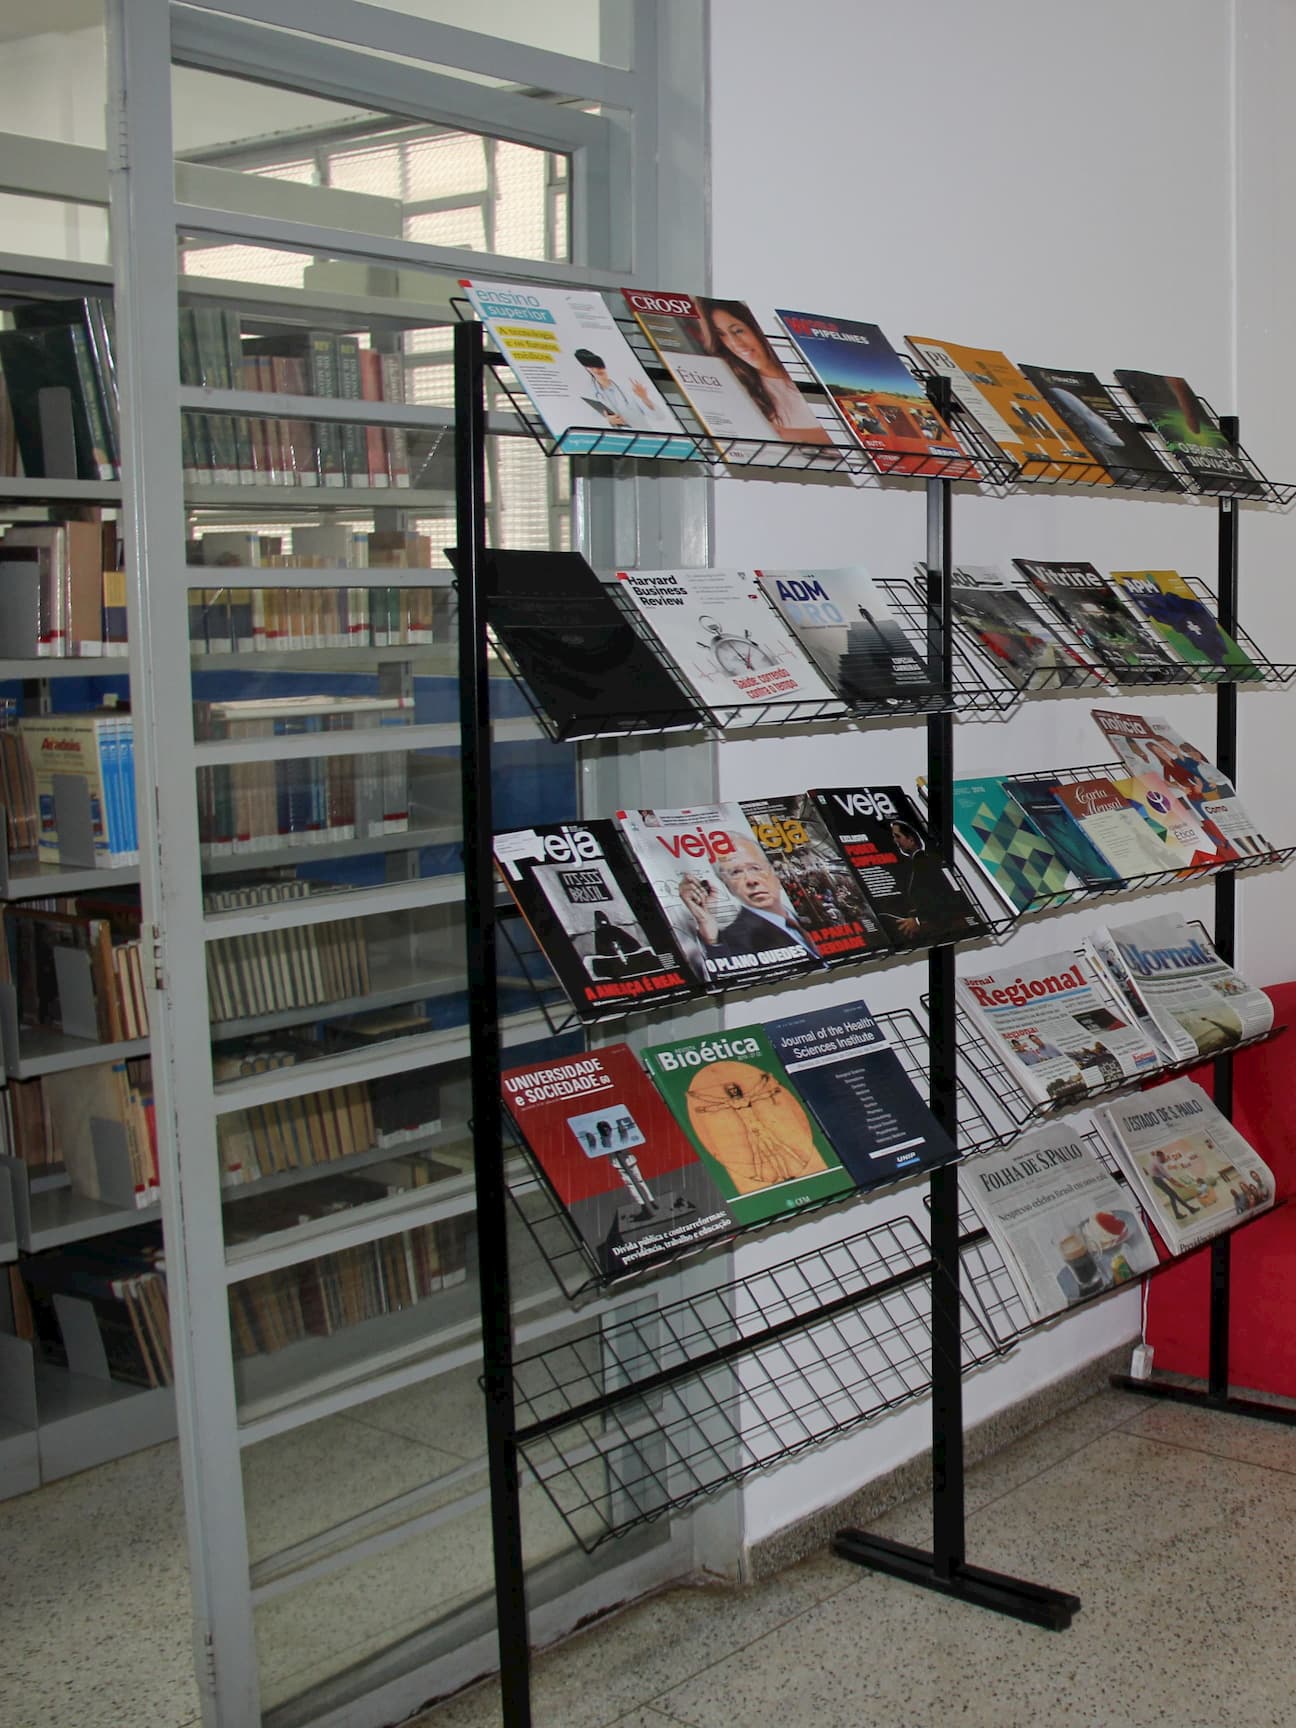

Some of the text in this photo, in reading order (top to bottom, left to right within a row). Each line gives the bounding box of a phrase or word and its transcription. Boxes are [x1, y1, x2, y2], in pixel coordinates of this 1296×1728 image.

[476, 288, 540, 307] ensino
[631, 296, 692, 315] CROSP
[488, 304, 547, 321] superior
[811, 328, 869, 345] PIPELINES
[924, 350, 956, 368] PB
[677, 366, 722, 387] Ética
[628, 575, 677, 587] Harvard
[1024, 564, 1104, 587] Vitrine
[1122, 577, 1161, 594] APM
[633, 586, 688, 597] Business
[640, 597, 685, 607] Review
[775, 580, 830, 602] ADM
[784, 602, 843, 624] PRO
[832, 788, 899, 822] veja
[1075, 785, 1108, 804] Carta
[1082, 798, 1124, 818] Mensal
[656, 826, 737, 865] veja
[705, 944, 808, 973] O PLANO GUEDES
[964, 975, 996, 987] Jornal
[968, 965, 1088, 1007] Regional
[780, 1016, 876, 1048] Journal of the Health
[657, 1037, 761, 1071] Bioética
[793, 1031, 876, 1058] Sciences Institute
[504, 1057, 605, 1092] UNIVERSIDADE
[514, 1095, 526, 1106] e
[524, 1073, 601, 1103] SOCIEDADE
[1127, 1111, 1160, 1132] ESTADO
[1156, 1107, 1173, 1122] DE
[978, 1166, 1026, 1193] FOLHA
[1018, 1158, 1043, 1177] DE
